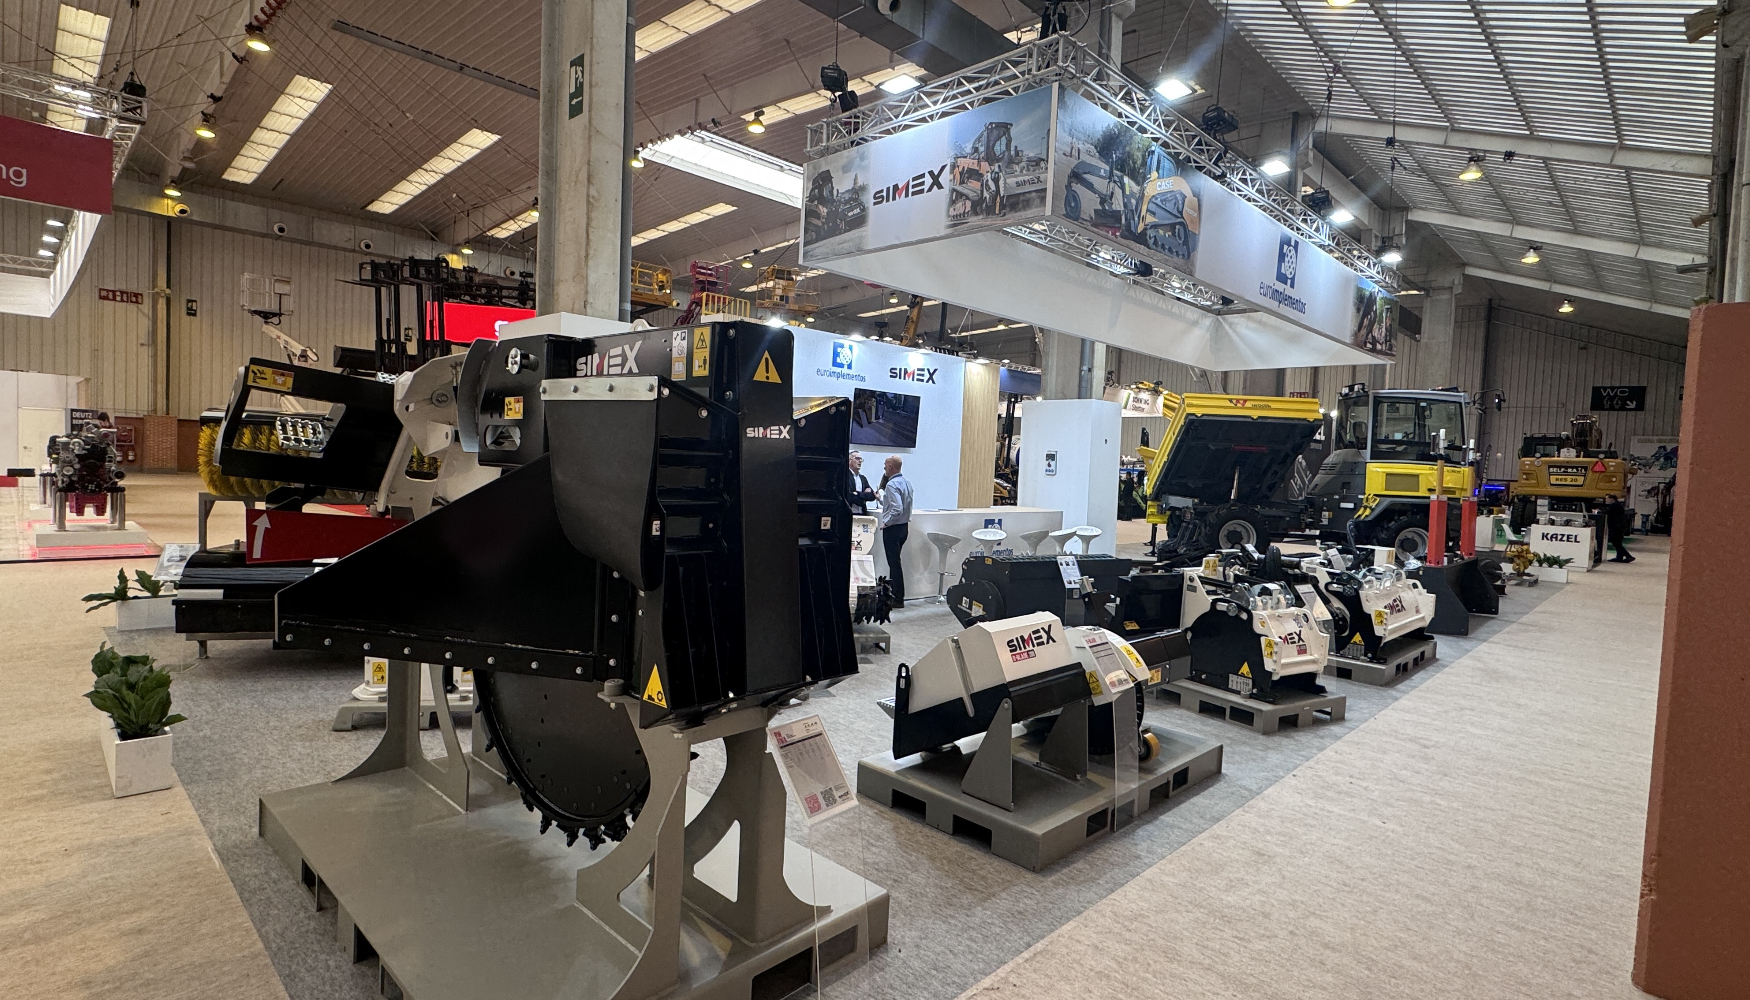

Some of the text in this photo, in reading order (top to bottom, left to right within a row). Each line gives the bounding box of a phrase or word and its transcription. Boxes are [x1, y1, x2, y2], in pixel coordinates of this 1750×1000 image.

[872, 163, 948, 207] SIMEX
[1015, 175, 1042, 187] SIMEX
[1156, 180, 1174, 190] CASE
[1259, 281, 1306, 314] euroimplementos
[576, 340, 643, 377] SIMEX
[816, 367, 866, 382] euroimplementos
[889, 367, 938, 384] SIMEX
[1600, 388, 1629, 396] WC
[72, 411, 93, 419] DEUTZ
[746, 425, 791, 440] SIMEX
[1541, 532, 1581, 543] KAZEL
[1006, 623, 1057, 653] SIMEX
